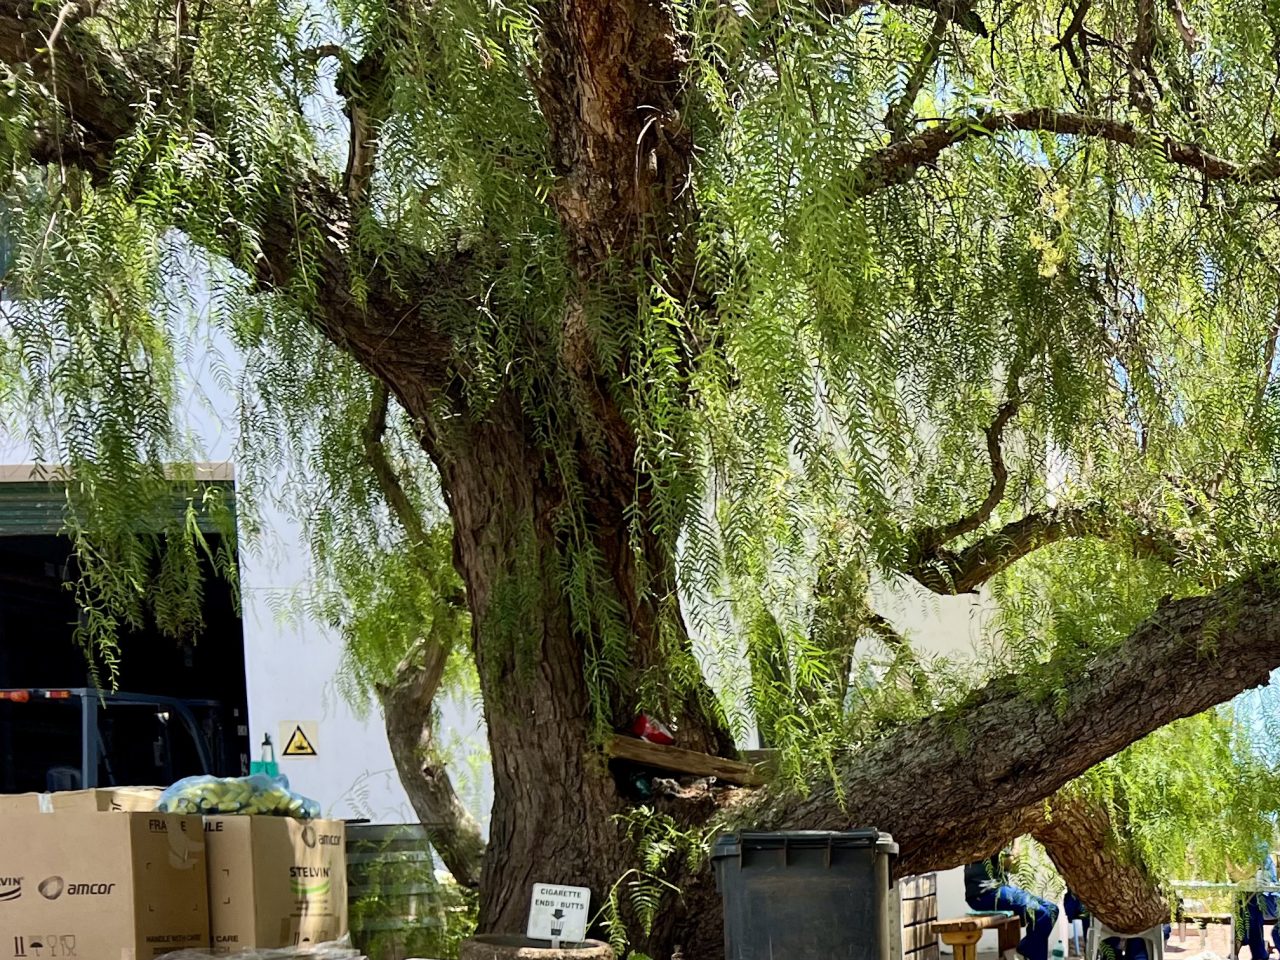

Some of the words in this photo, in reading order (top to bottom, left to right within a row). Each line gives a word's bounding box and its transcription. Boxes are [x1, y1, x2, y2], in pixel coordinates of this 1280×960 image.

[318, 834, 341, 846] amcor
[67, 883, 116, 895] amcor
[540, 888, 582, 899] CIGARETTE
[535, 899, 555, 907] ENDS
[560, 901, 584, 910] BUTTS
[215, 935, 239, 943] CARE
